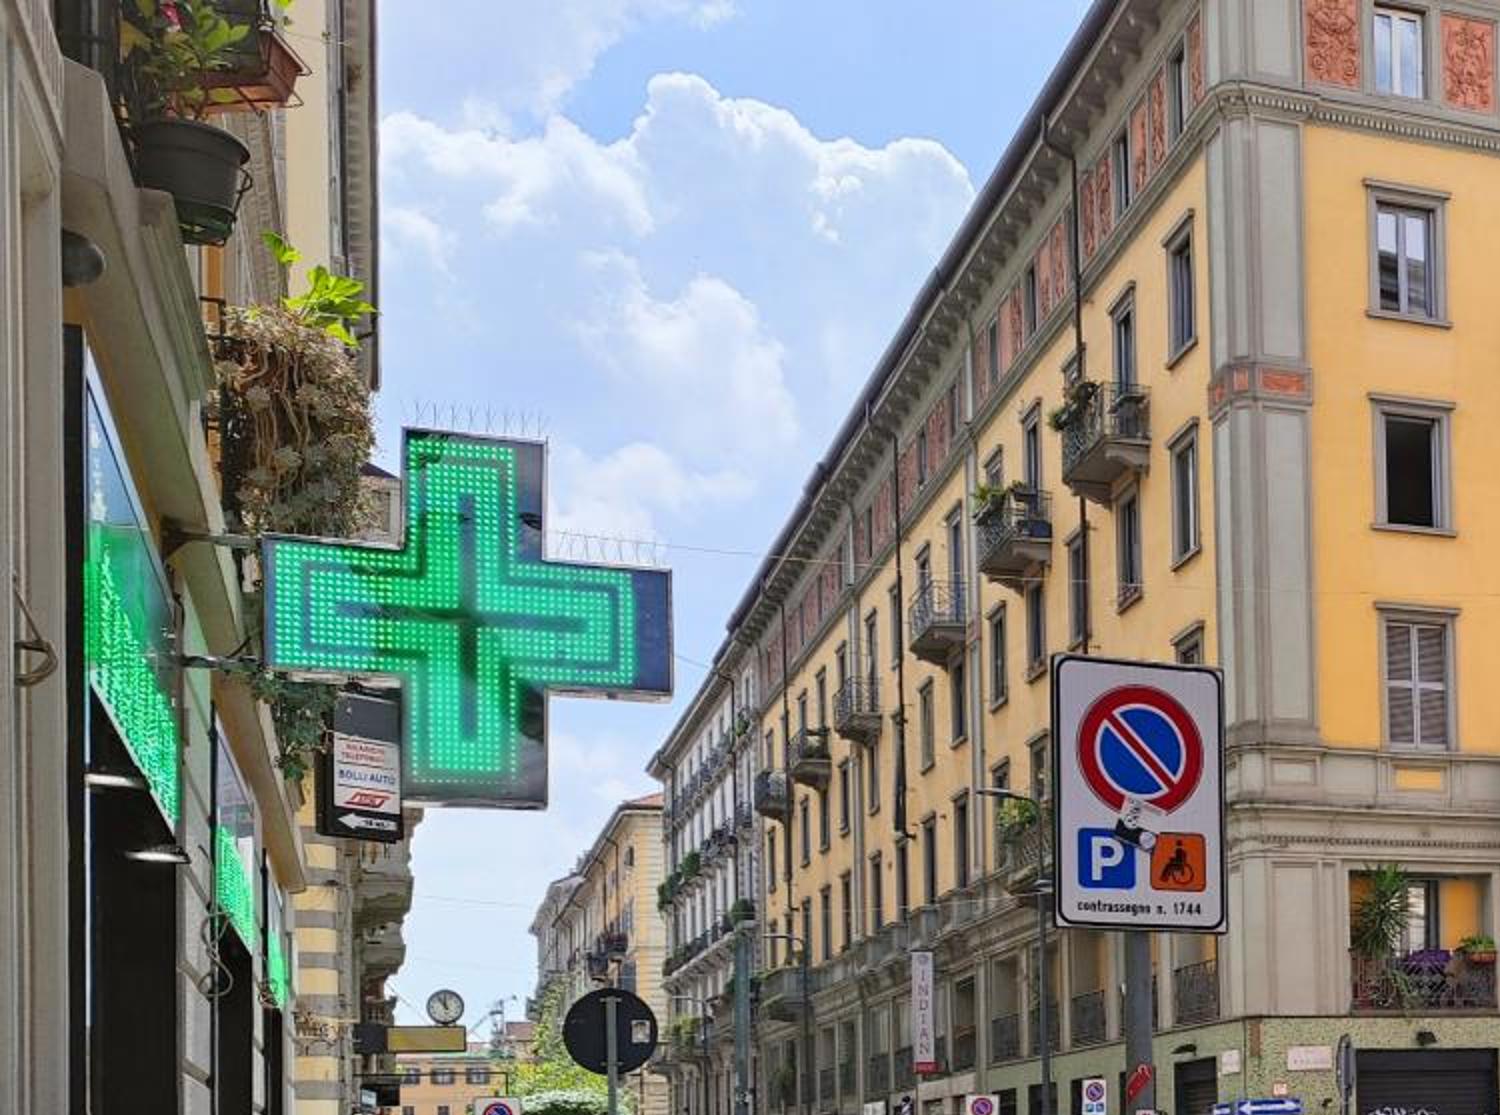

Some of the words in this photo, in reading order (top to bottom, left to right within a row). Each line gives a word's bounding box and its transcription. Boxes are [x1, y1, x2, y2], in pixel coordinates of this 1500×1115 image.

[338, 768, 367, 781] BOLLI
[370, 773, 396, 785] AUTO
[1091, 836, 1125, 881] P
[1077, 899, 1152, 916] contrassegno
[1173, 901, 1201, 916] 1744
